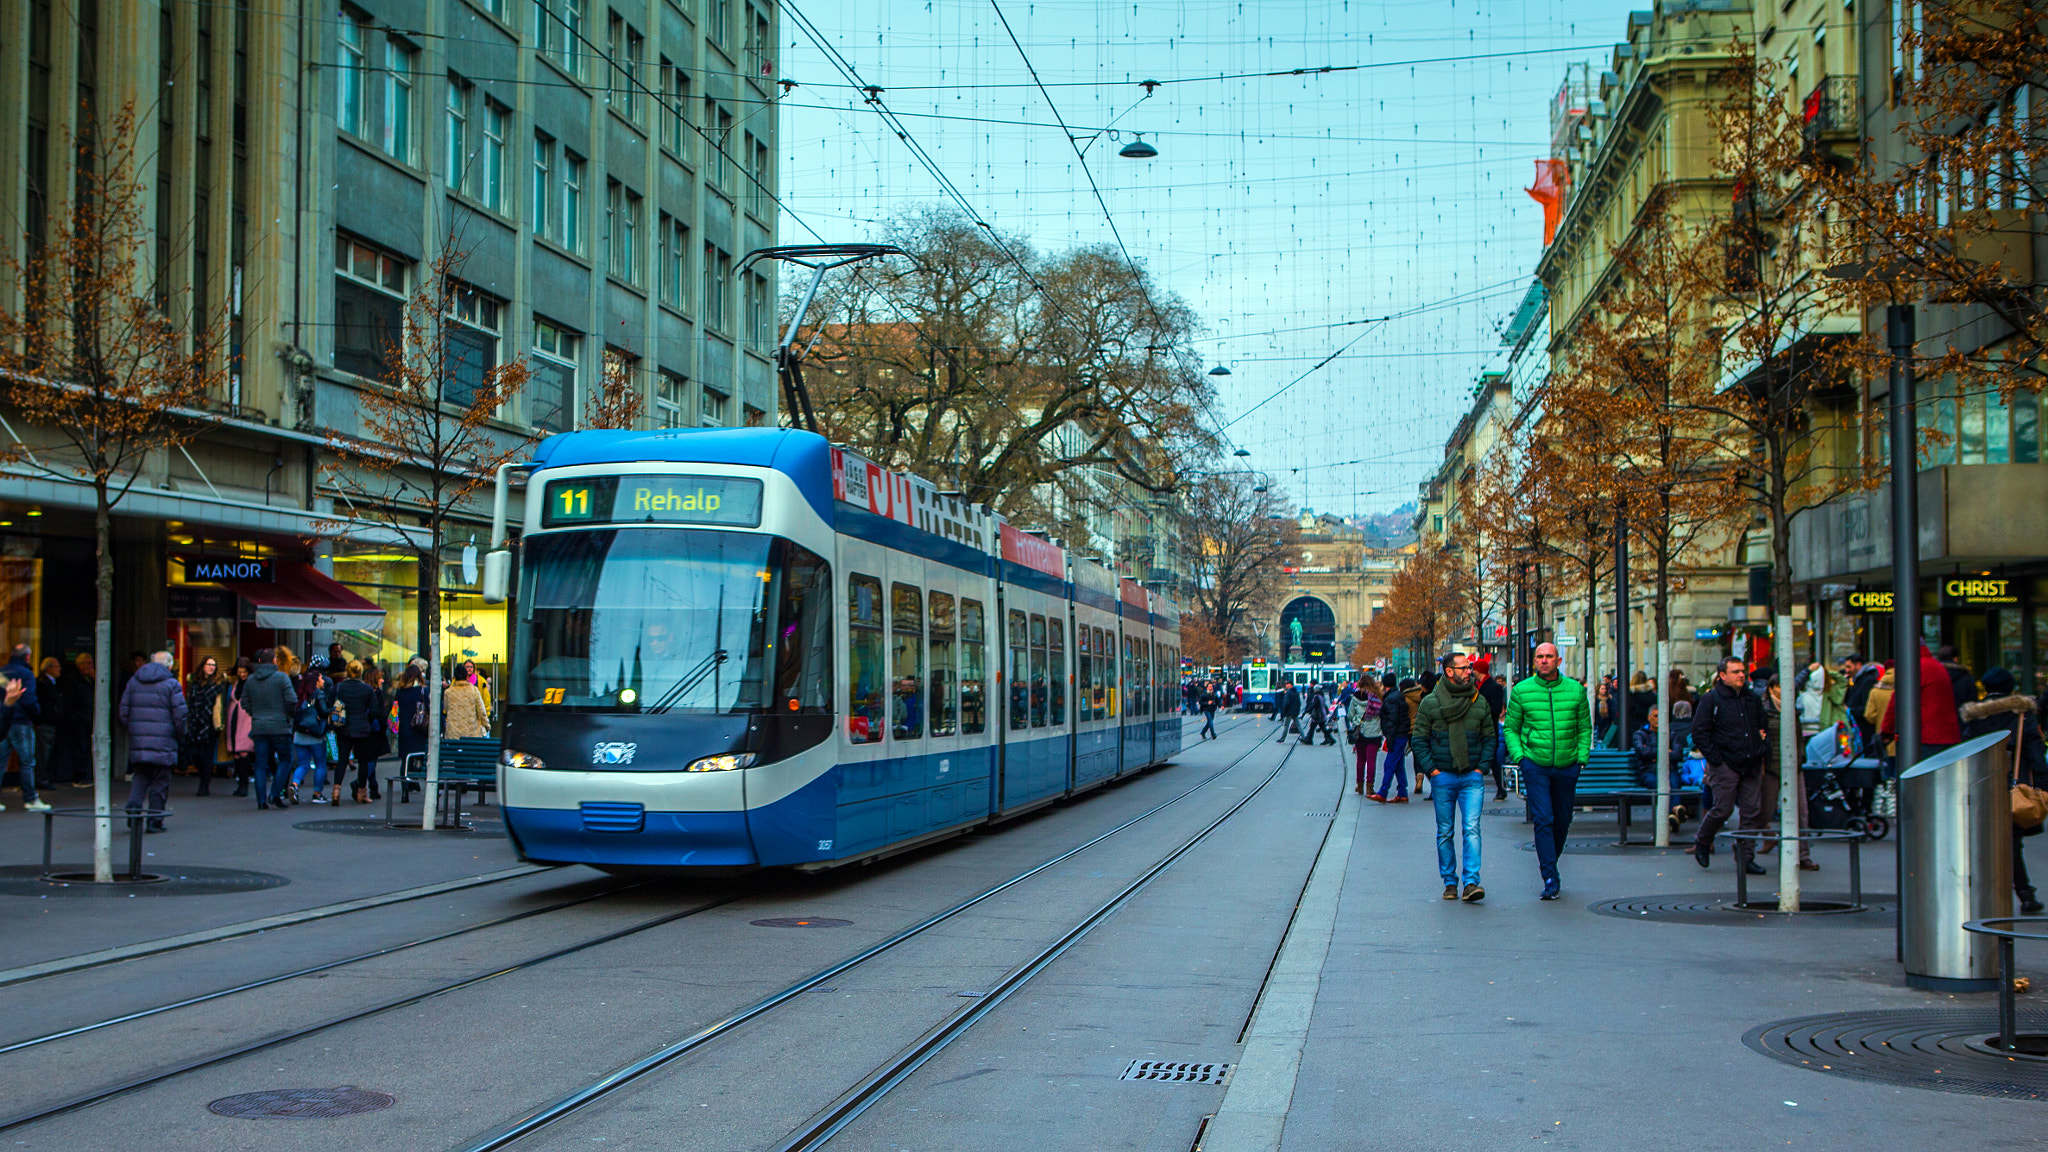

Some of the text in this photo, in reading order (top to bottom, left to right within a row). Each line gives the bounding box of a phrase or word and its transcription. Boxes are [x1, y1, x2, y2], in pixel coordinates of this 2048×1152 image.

[560, 489, 588, 514] 11
[634, 487, 721, 514] Rehalp
[195, 563, 262, 579] MANOR
[1945, 580, 2009, 596] CHRIST
[1848, 592, 1895, 607] CHRIS
